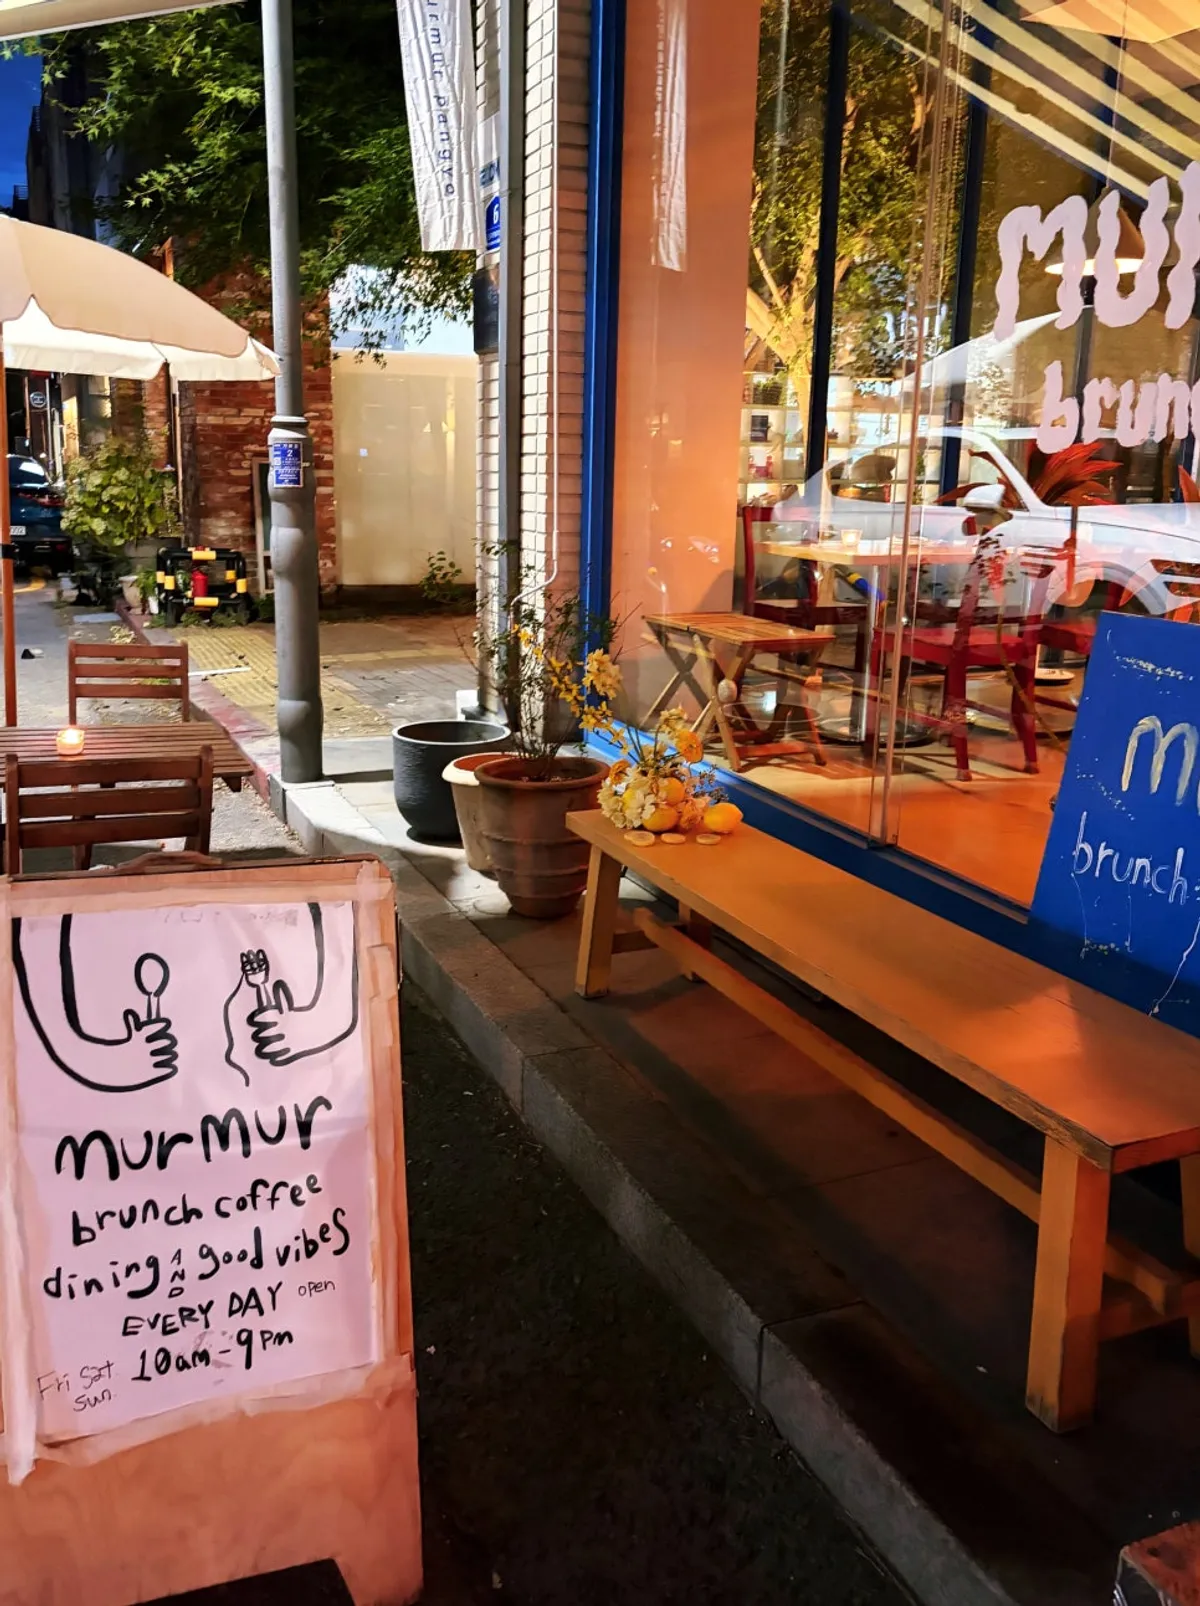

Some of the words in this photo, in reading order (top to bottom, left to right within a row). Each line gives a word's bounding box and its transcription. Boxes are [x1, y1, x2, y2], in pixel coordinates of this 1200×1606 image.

[434, 94, 455, 195] pangyo
[1036, 359, 1200, 454] brun
[72, 1193, 203, 1247] brunch
[215, 1173, 323, 1219] coffee
[43, 1254, 161, 1300] dining
[198, 1226, 264, 1281] good
[276, 1206, 351, 1267] vibes
[122, 1299, 214, 1337] EVERY
[228, 1281, 283, 1319] DAY
[297, 1279, 336, 1297] open
[37, 1370, 70, 1401] Fri
